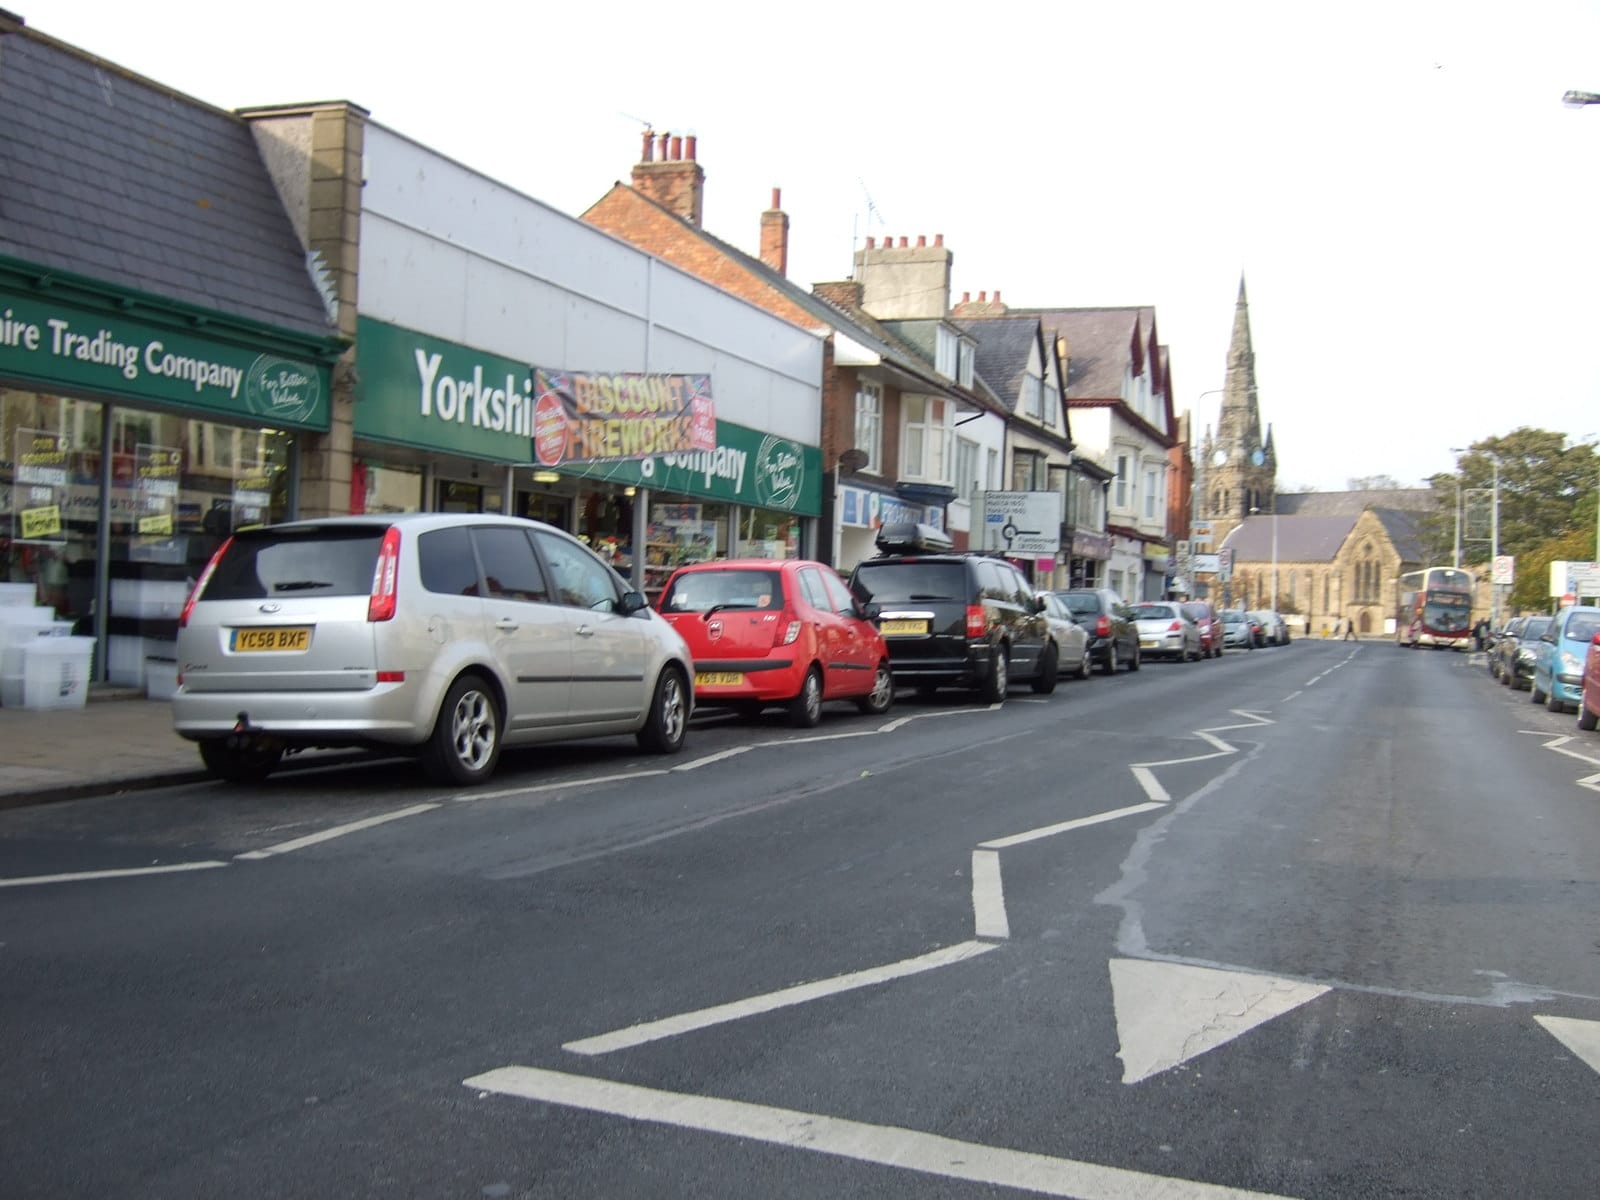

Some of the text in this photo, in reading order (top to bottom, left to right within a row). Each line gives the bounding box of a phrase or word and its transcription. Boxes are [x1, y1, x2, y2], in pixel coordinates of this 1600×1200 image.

[48, 318, 139, 379] Trading
[144, 342, 243, 398] Company
[574, 374, 684, 414] DISCOUNT
[239, 630, 307, 648] YC58 BXF
